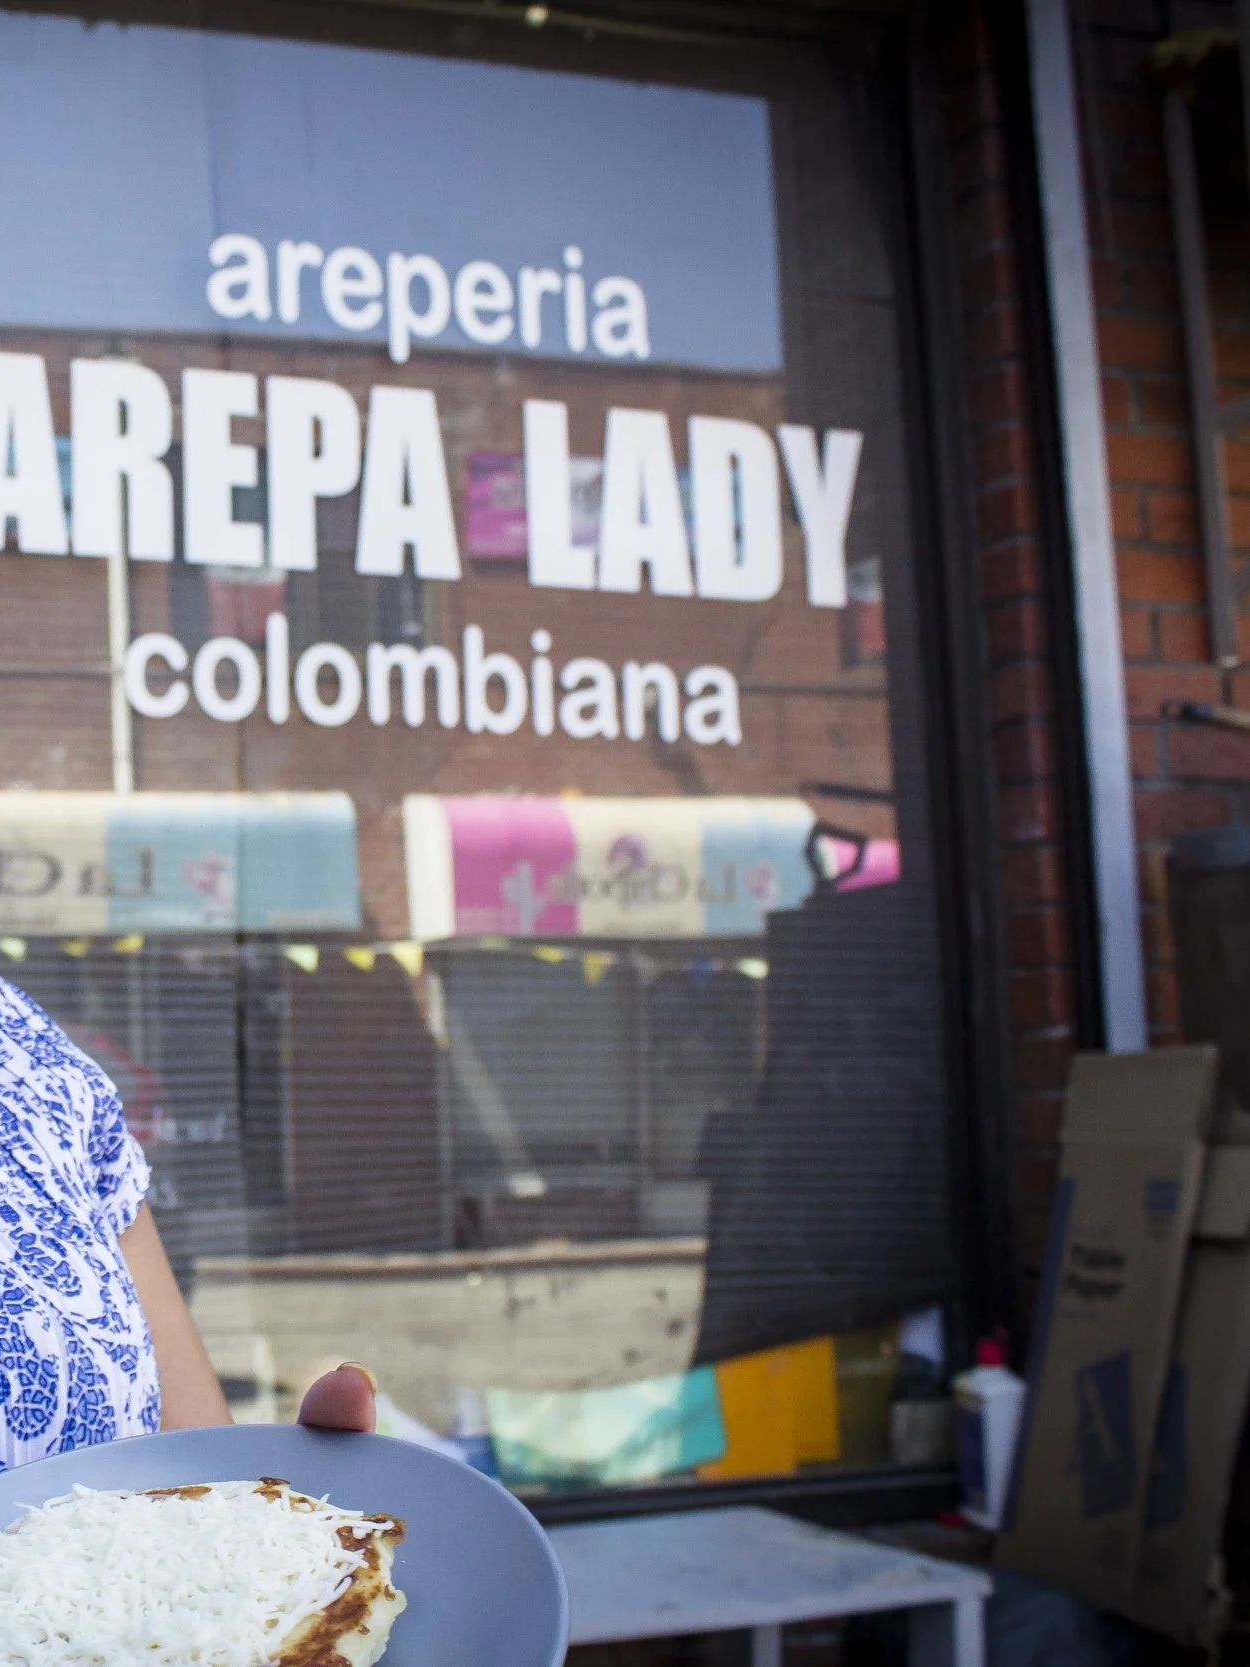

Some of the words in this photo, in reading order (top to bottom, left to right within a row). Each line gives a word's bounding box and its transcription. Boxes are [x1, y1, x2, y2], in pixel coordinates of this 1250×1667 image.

[206, 232, 651, 363] areperia
[523, 398, 863, 607] LADY
[125, 611, 743, 746] colombiana
